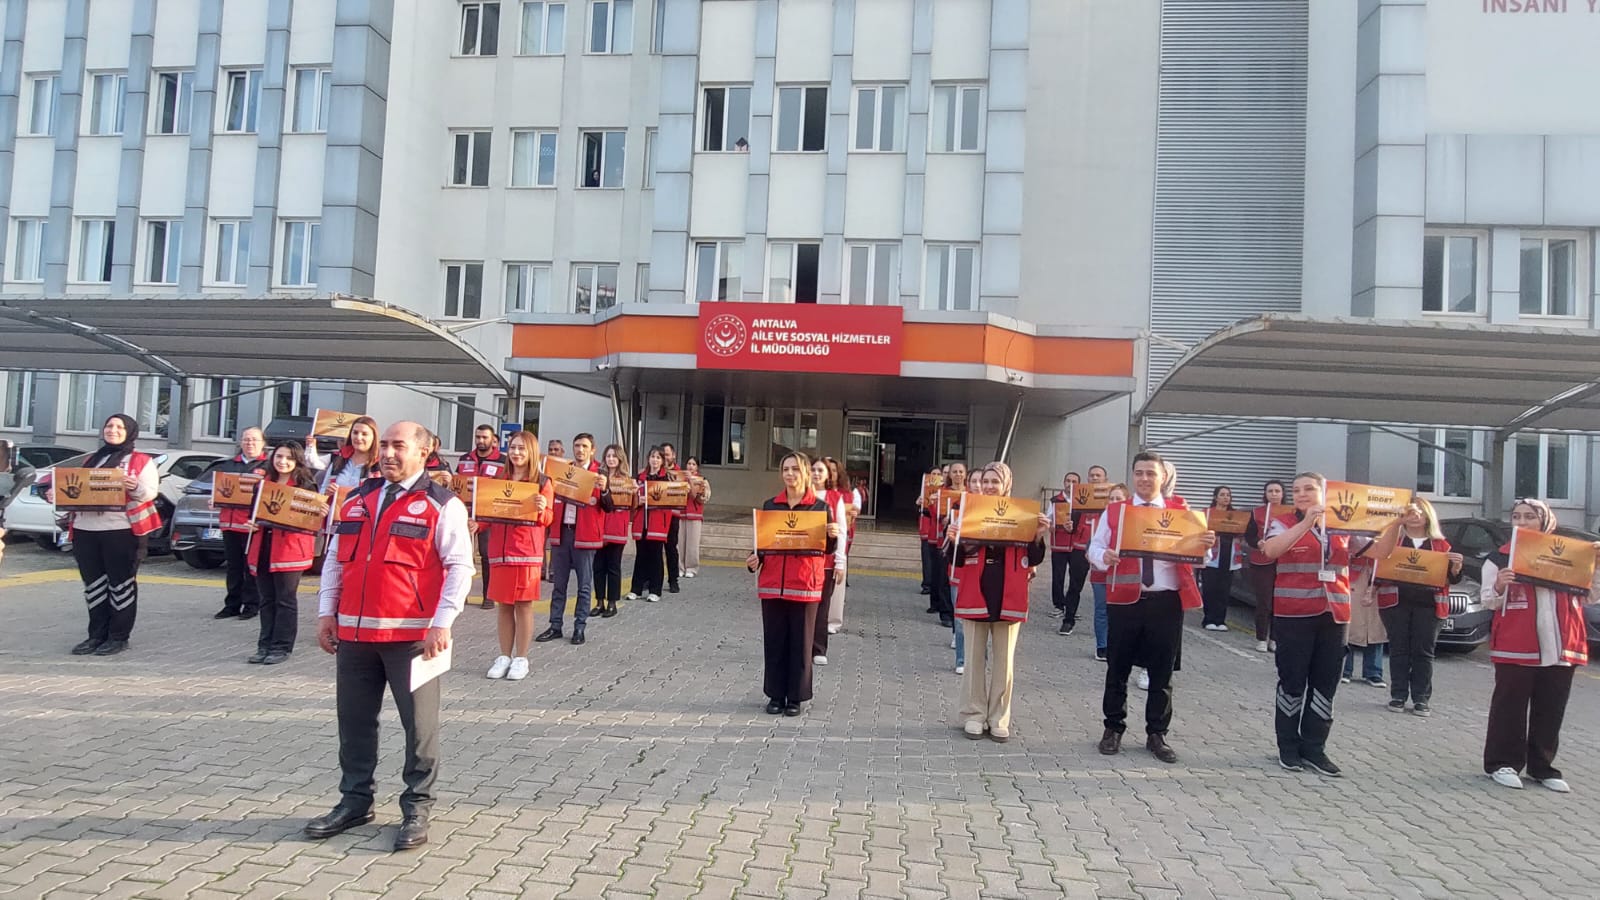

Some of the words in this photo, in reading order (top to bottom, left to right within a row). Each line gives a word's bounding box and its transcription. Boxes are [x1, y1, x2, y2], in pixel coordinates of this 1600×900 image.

[752, 318, 797, 329] ANTALYA
[752, 330, 774, 341] AİLE
[776, 332, 789, 342] VE
[791, 332, 830, 343] SOSYAL
[832, 333, 890, 345] HİZMETLER
[751, 342, 760, 354] İL
[762, 342, 830, 356] MÜDÜRLÜĞÜ
